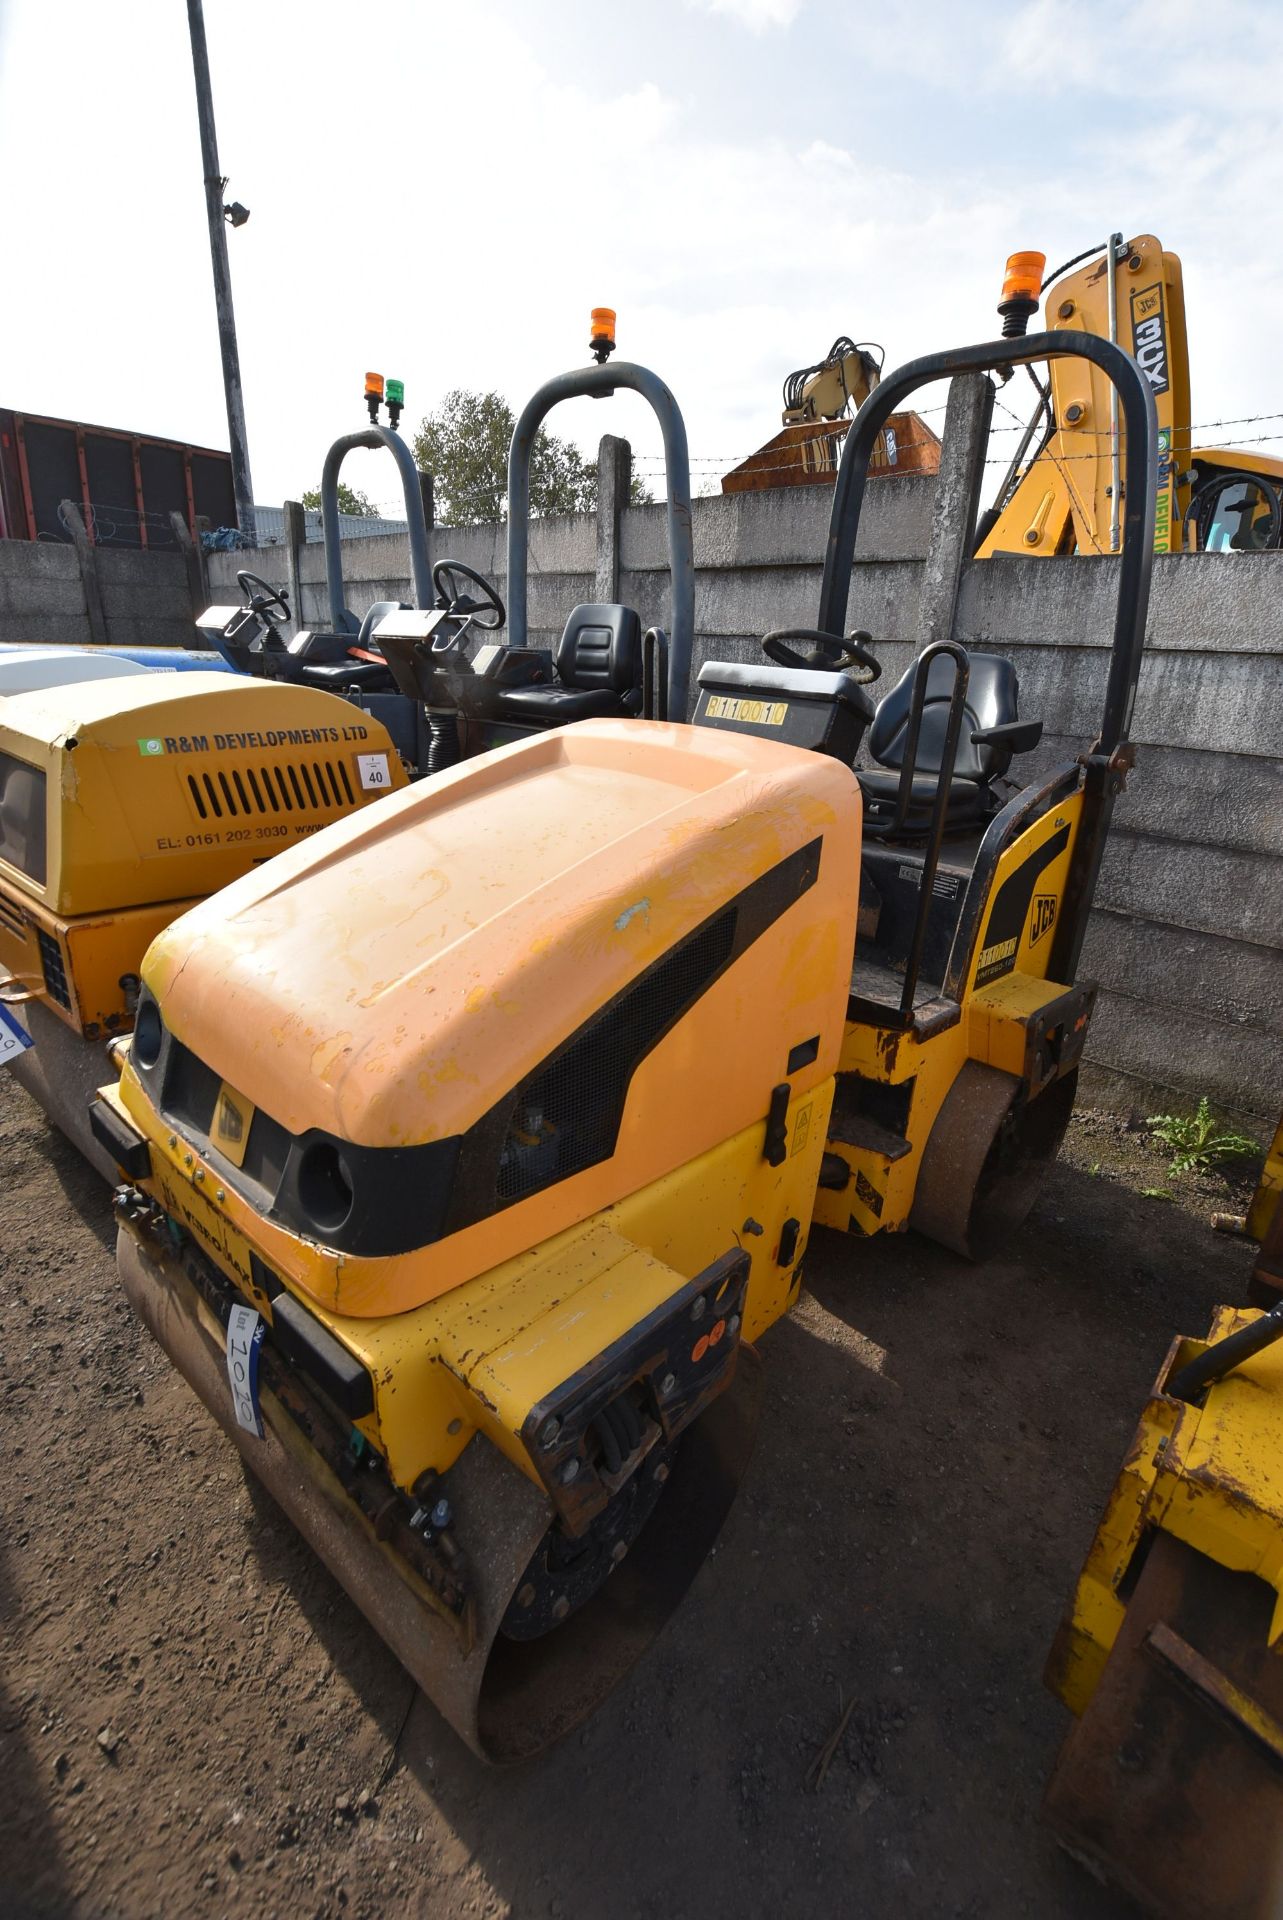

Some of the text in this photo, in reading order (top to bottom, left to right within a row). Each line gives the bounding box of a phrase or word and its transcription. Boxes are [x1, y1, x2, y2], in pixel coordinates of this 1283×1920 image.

[1136, 317, 1168, 384] 3CX
[706, 697, 786, 723] R110010
[164, 726, 368, 754] R&M DEVELOPMENTS LTD
[369, 771, 383, 783] 40
[186, 833, 221, 847] 0161
[226, 830, 251, 843] 202
[256, 825, 288, 839] 3030
[1031, 899, 1056, 942] JCB
[236, 1310, 250, 1331] Lot
